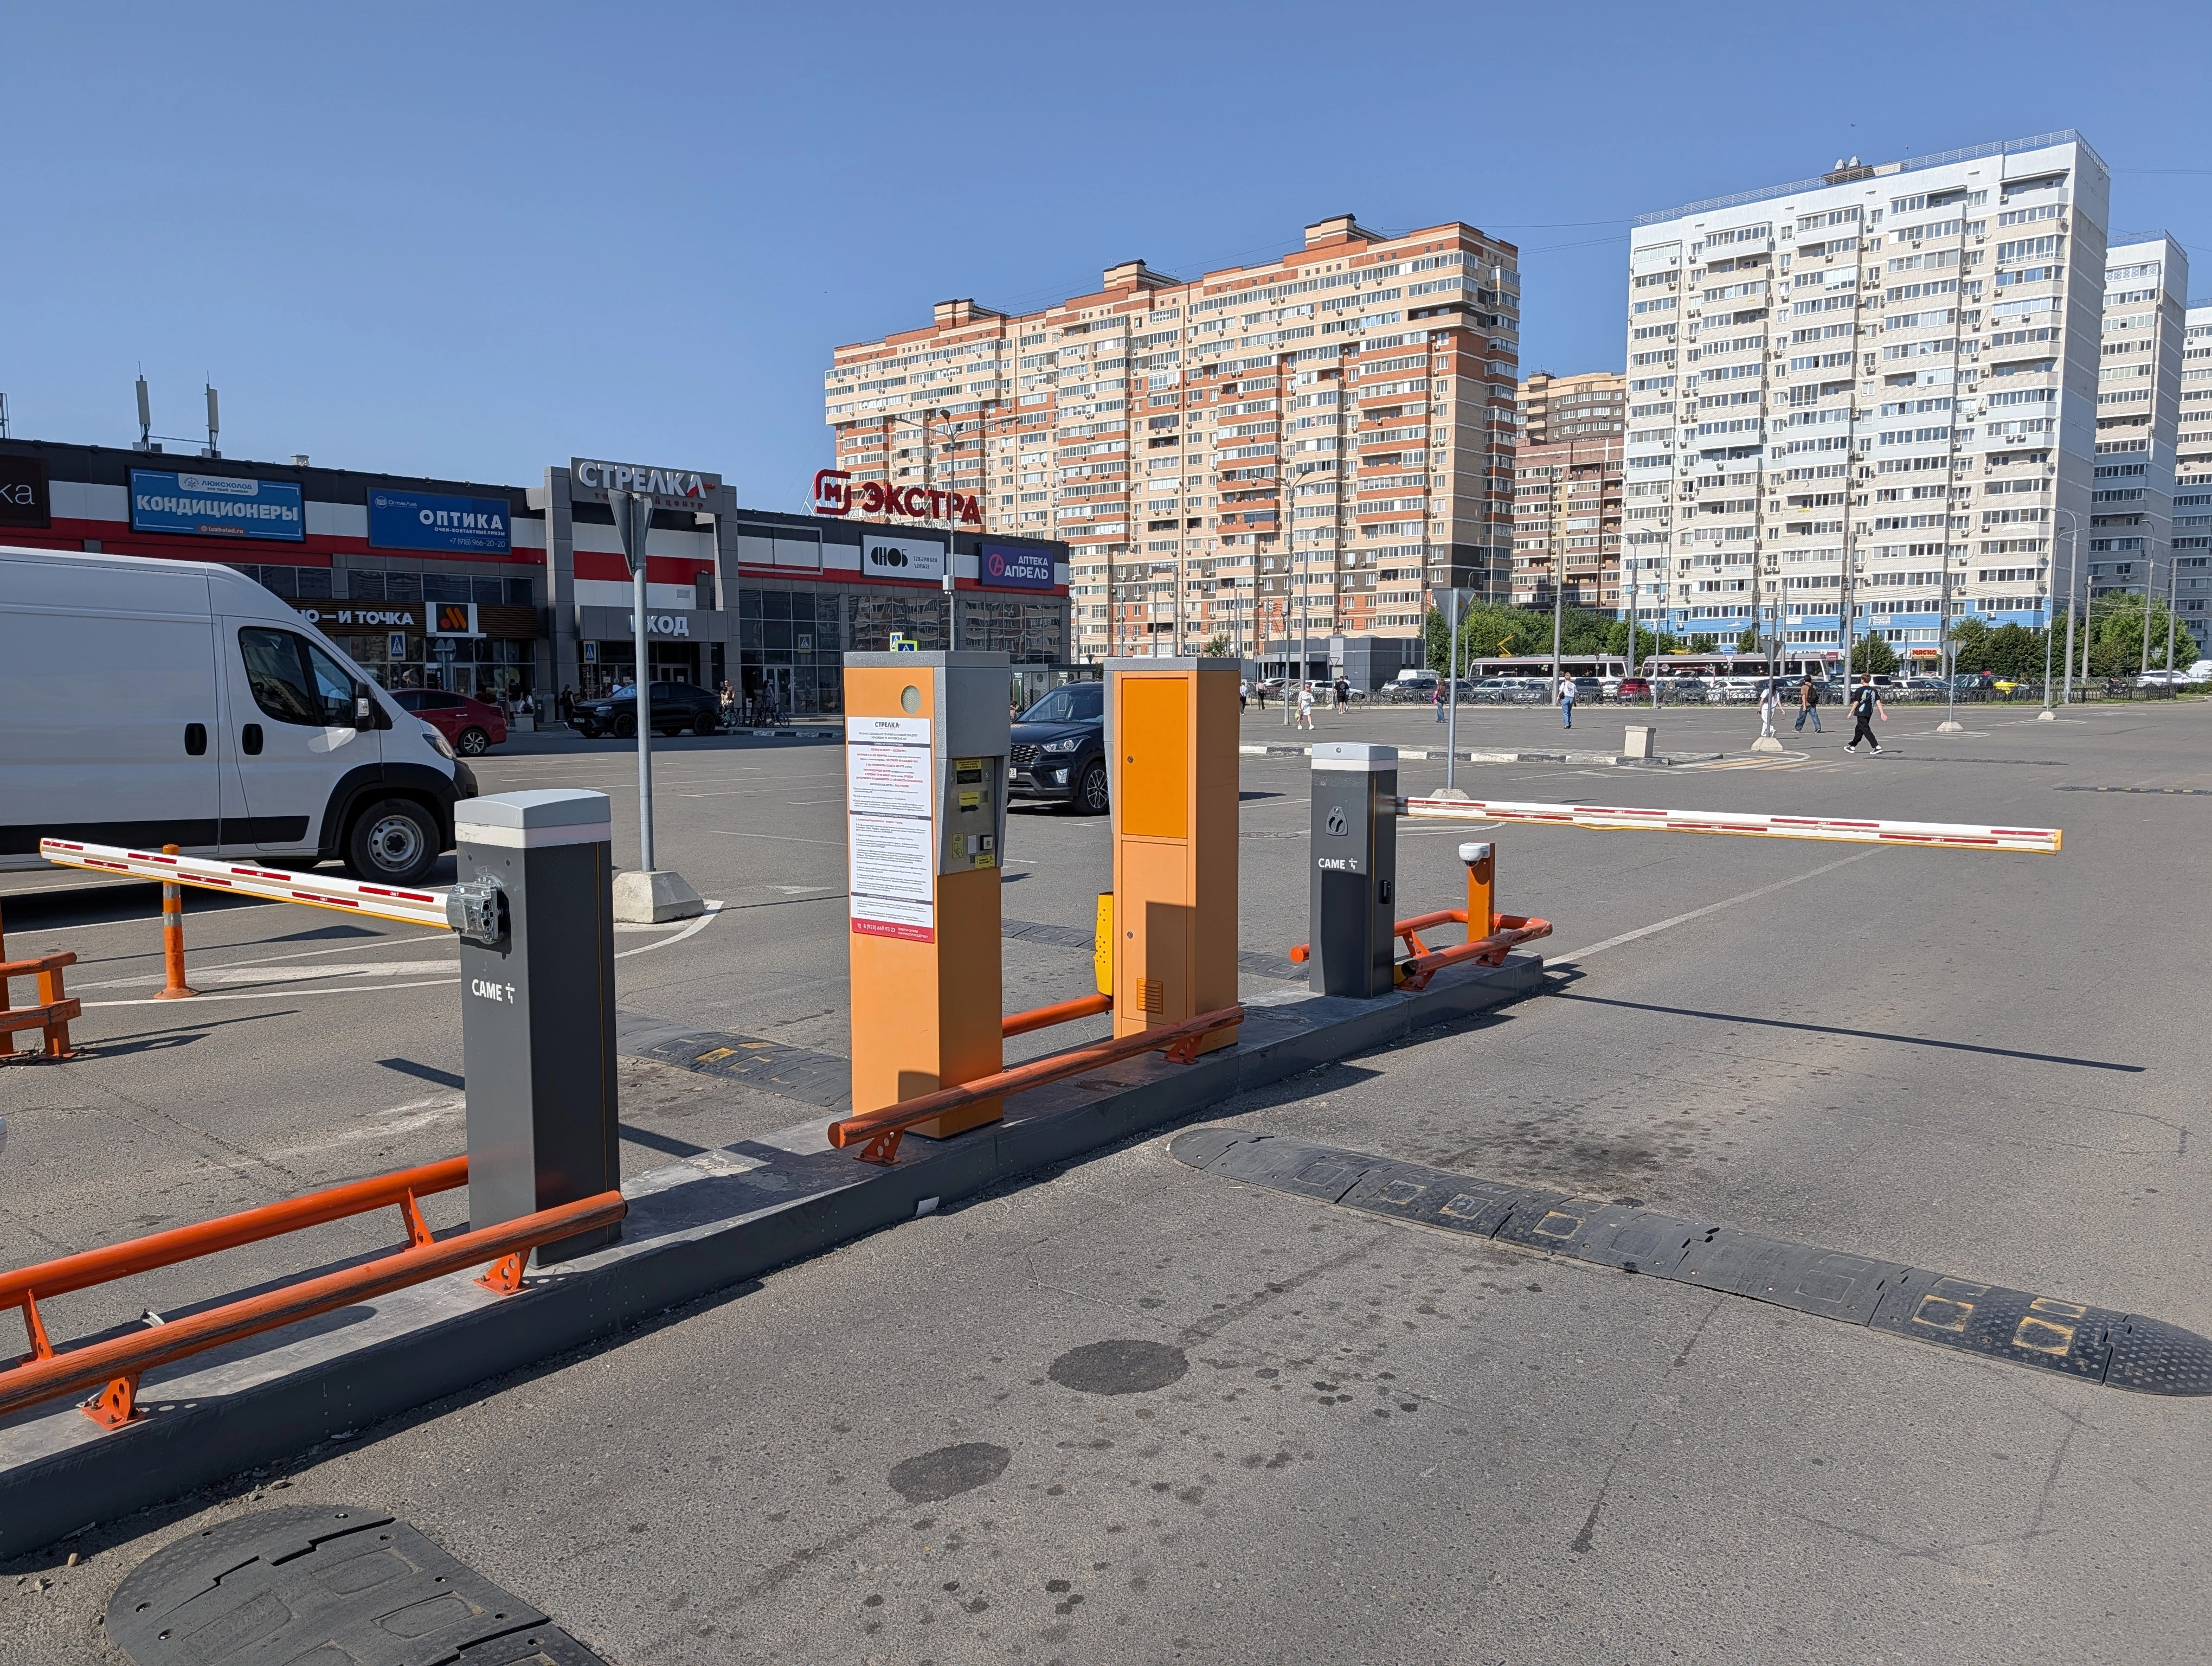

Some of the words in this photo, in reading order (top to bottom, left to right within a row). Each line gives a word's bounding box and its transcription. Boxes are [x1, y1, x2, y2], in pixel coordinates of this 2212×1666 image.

[202, 480, 253, 490] ЛЮКСХОЛОД
[578, 462, 707, 498] СТРЕЛКА
[137, 495, 298, 521] КОНДИЦИОНЕРЫ
[666, 499, 703, 510] центр
[861, 482, 982, 524] ЭКСТРА
[419, 509, 503, 530] ОПТИКА
[458, 537, 471, 546] (918)
[472, 539, 505, 547] 966-20-20
[871, 546, 908, 567] СНОБ
[1018, 555, 1049, 566] АПТЕКА
[1004, 565, 1049, 580] АПРЕЛЬ
[338, 611, 351, 623] И
[355, 611, 414, 625] ТОЧКА
[1318, 858, 1346, 869] CAME
[472, 978, 503, 1002] CAME
